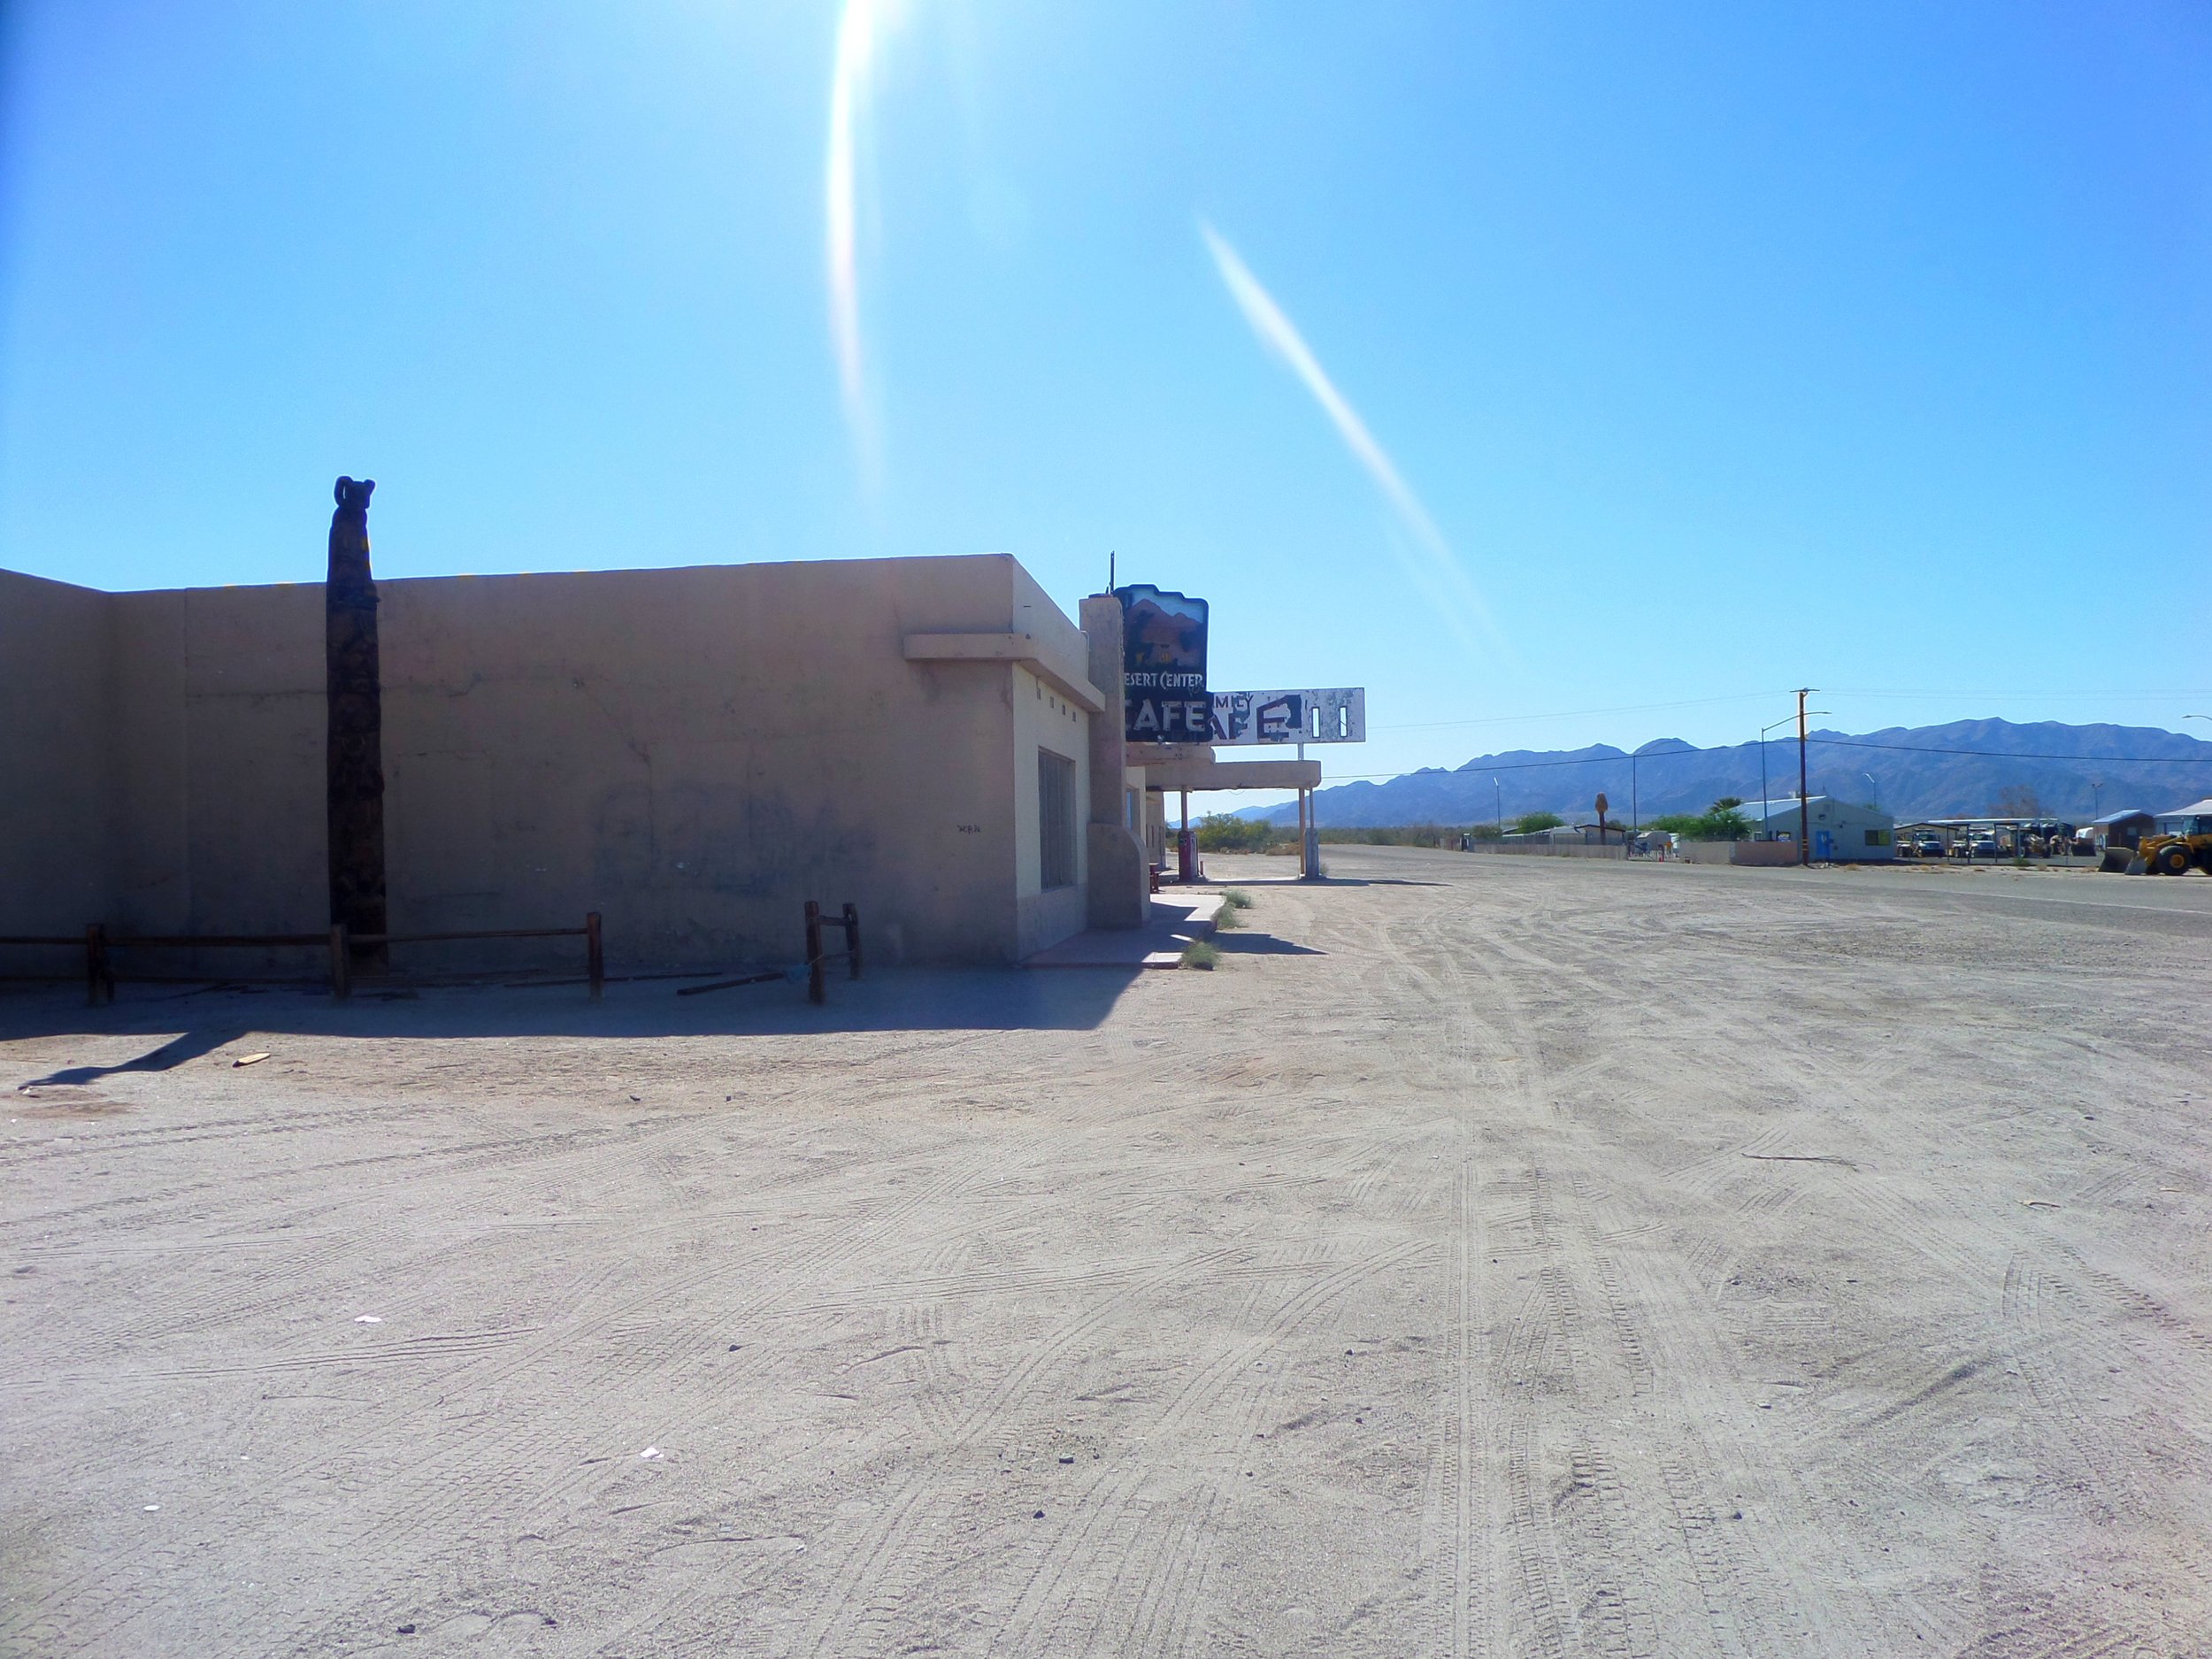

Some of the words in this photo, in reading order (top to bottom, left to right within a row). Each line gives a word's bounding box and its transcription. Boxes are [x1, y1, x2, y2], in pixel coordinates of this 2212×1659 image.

[1124, 672, 1159, 687] ESERT
[1159, 671, 1204, 689] CENTER
[1215, 693, 1254, 709] MILY
[1209, 699, 1294, 740] AFE
